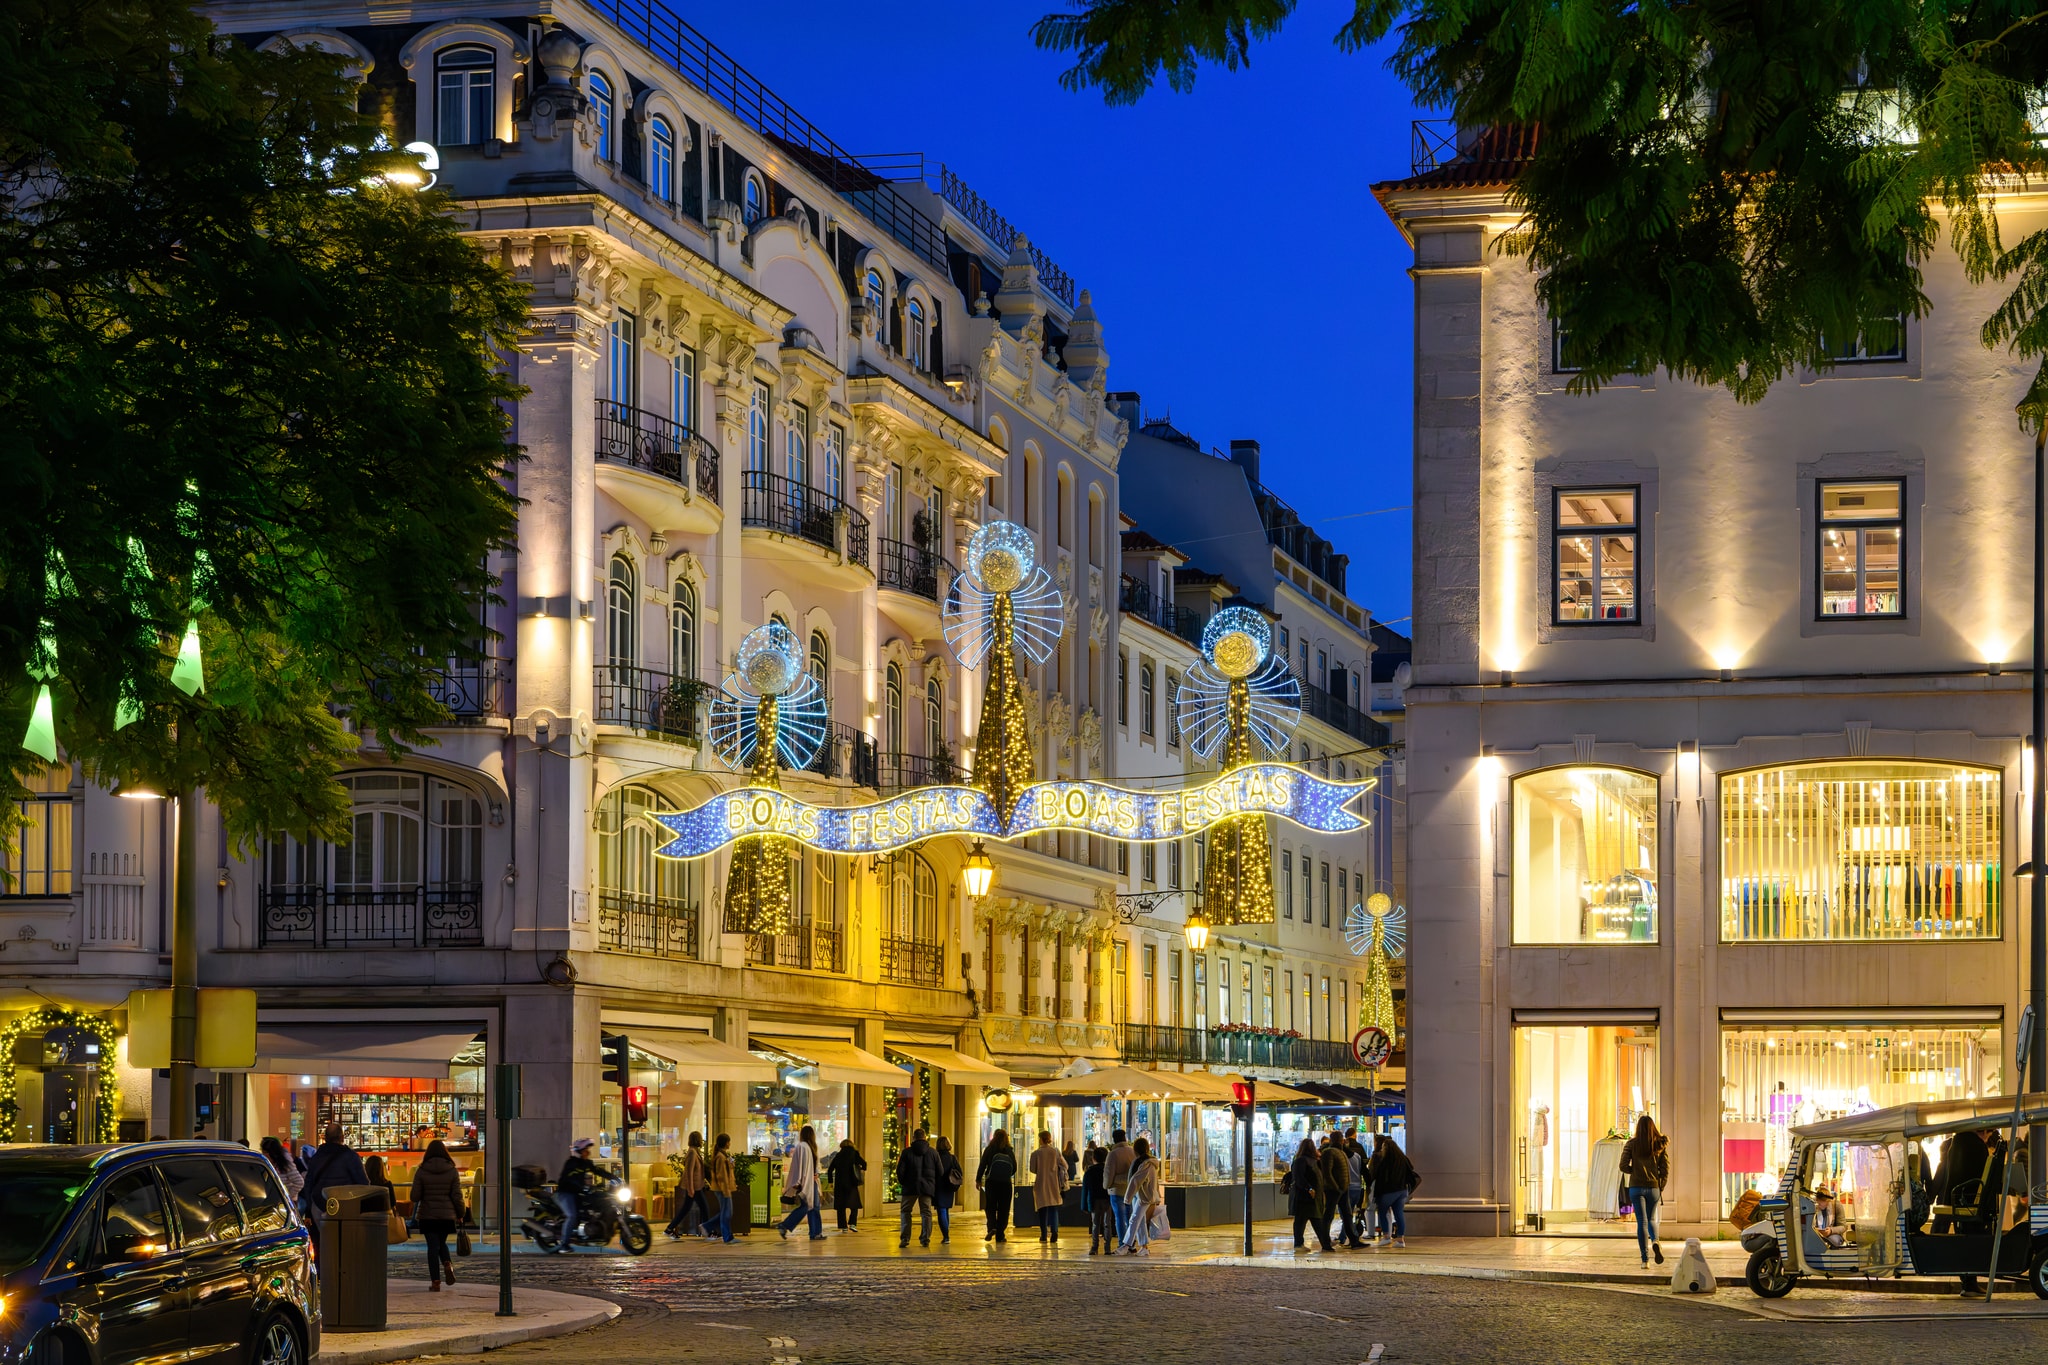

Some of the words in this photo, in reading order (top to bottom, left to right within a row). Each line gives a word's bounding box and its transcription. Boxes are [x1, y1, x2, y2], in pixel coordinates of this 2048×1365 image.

[728, 796, 817, 839] BOAS
[851, 795, 976, 846] FESTAS
[1040, 789, 1134, 829] BOAS
[1161, 774, 1290, 831] FESTAS
